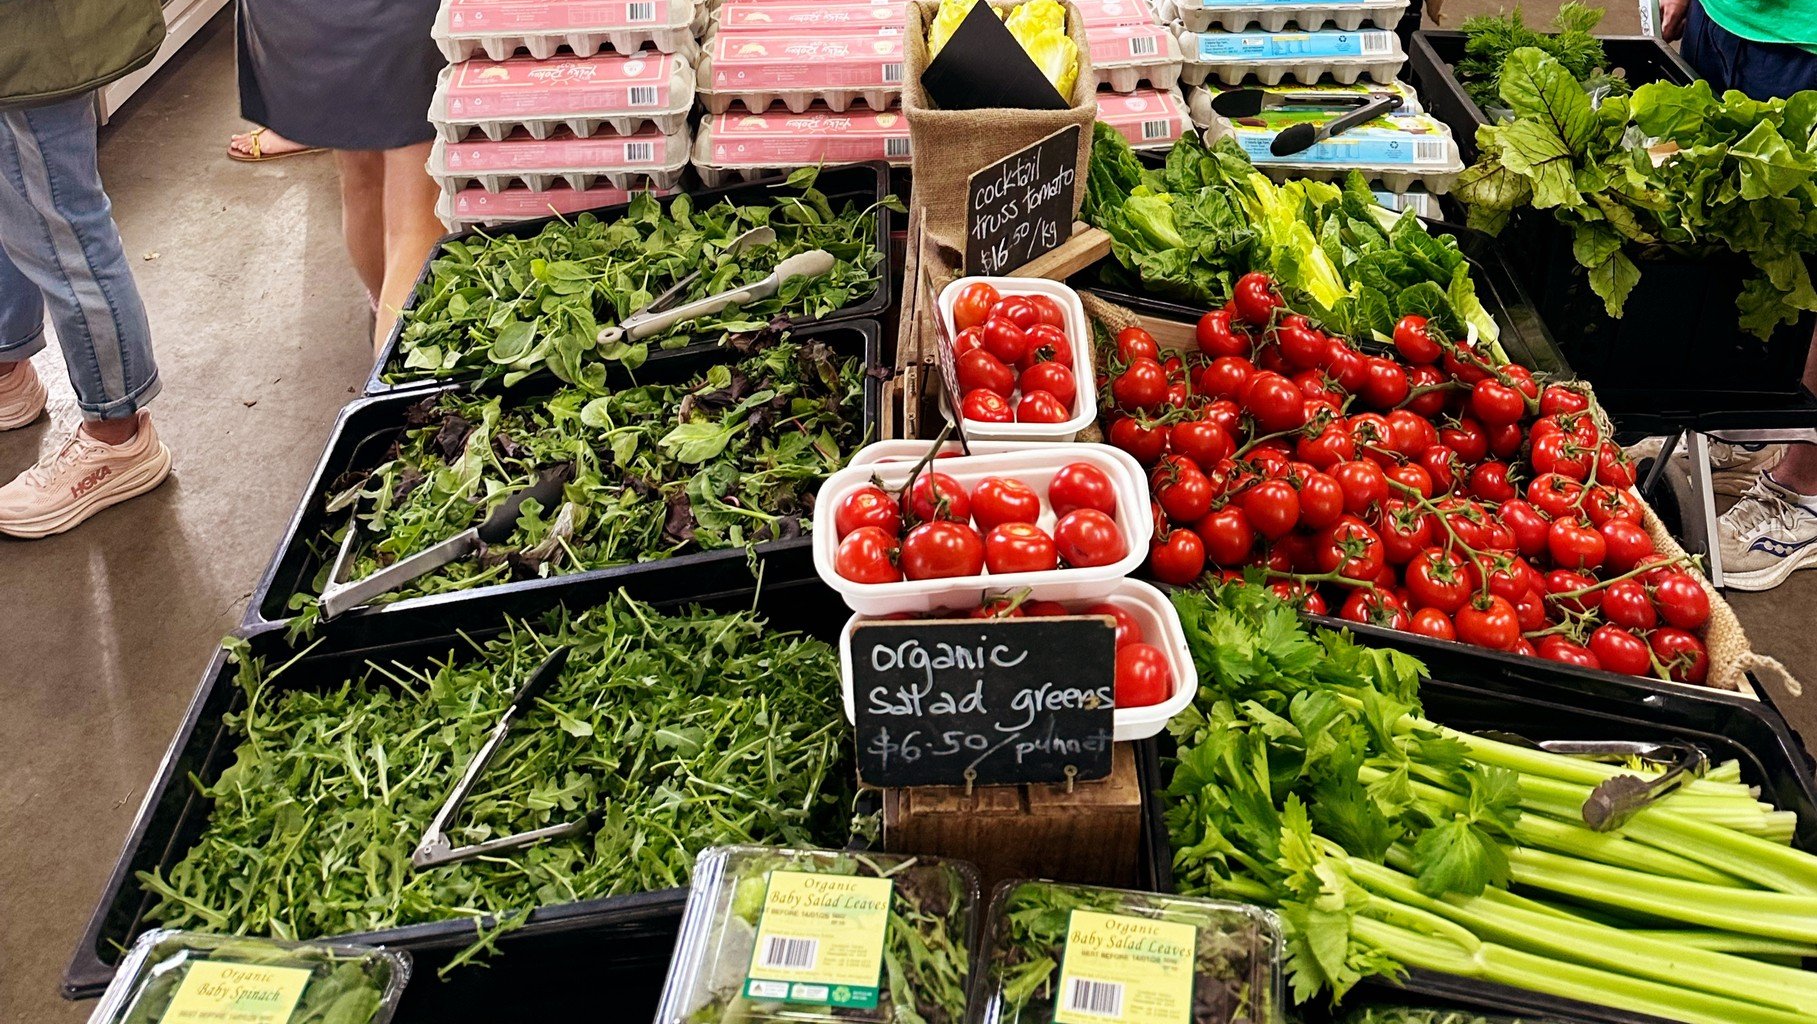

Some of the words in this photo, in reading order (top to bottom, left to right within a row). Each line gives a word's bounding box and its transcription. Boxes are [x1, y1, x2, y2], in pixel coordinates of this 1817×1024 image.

[975, 146, 1043, 211] cocktail
[972, 199, 1019, 240] truss
[1022, 164, 1075, 213] tomato
[70, 465, 112, 499] HOKA
[871, 634, 1028, 698] organic
[994, 682, 1115, 732] greens
[804, 877, 857, 892] Organic
[770, 890, 801, 906] Baby
[804, 893, 840, 908] Salad
[844, 896, 887, 911] Leaves
[1105, 918, 1160, 936] Organic
[1071, 930, 1102, 950] Baby
[1106, 935, 1143, 950] Salad
[1147, 939, 1192, 958] Leaves
[221, 968, 273, 984] Organic
[198, 983, 229, 1002] Baby
[229, 986, 283, 1004] Spinach
